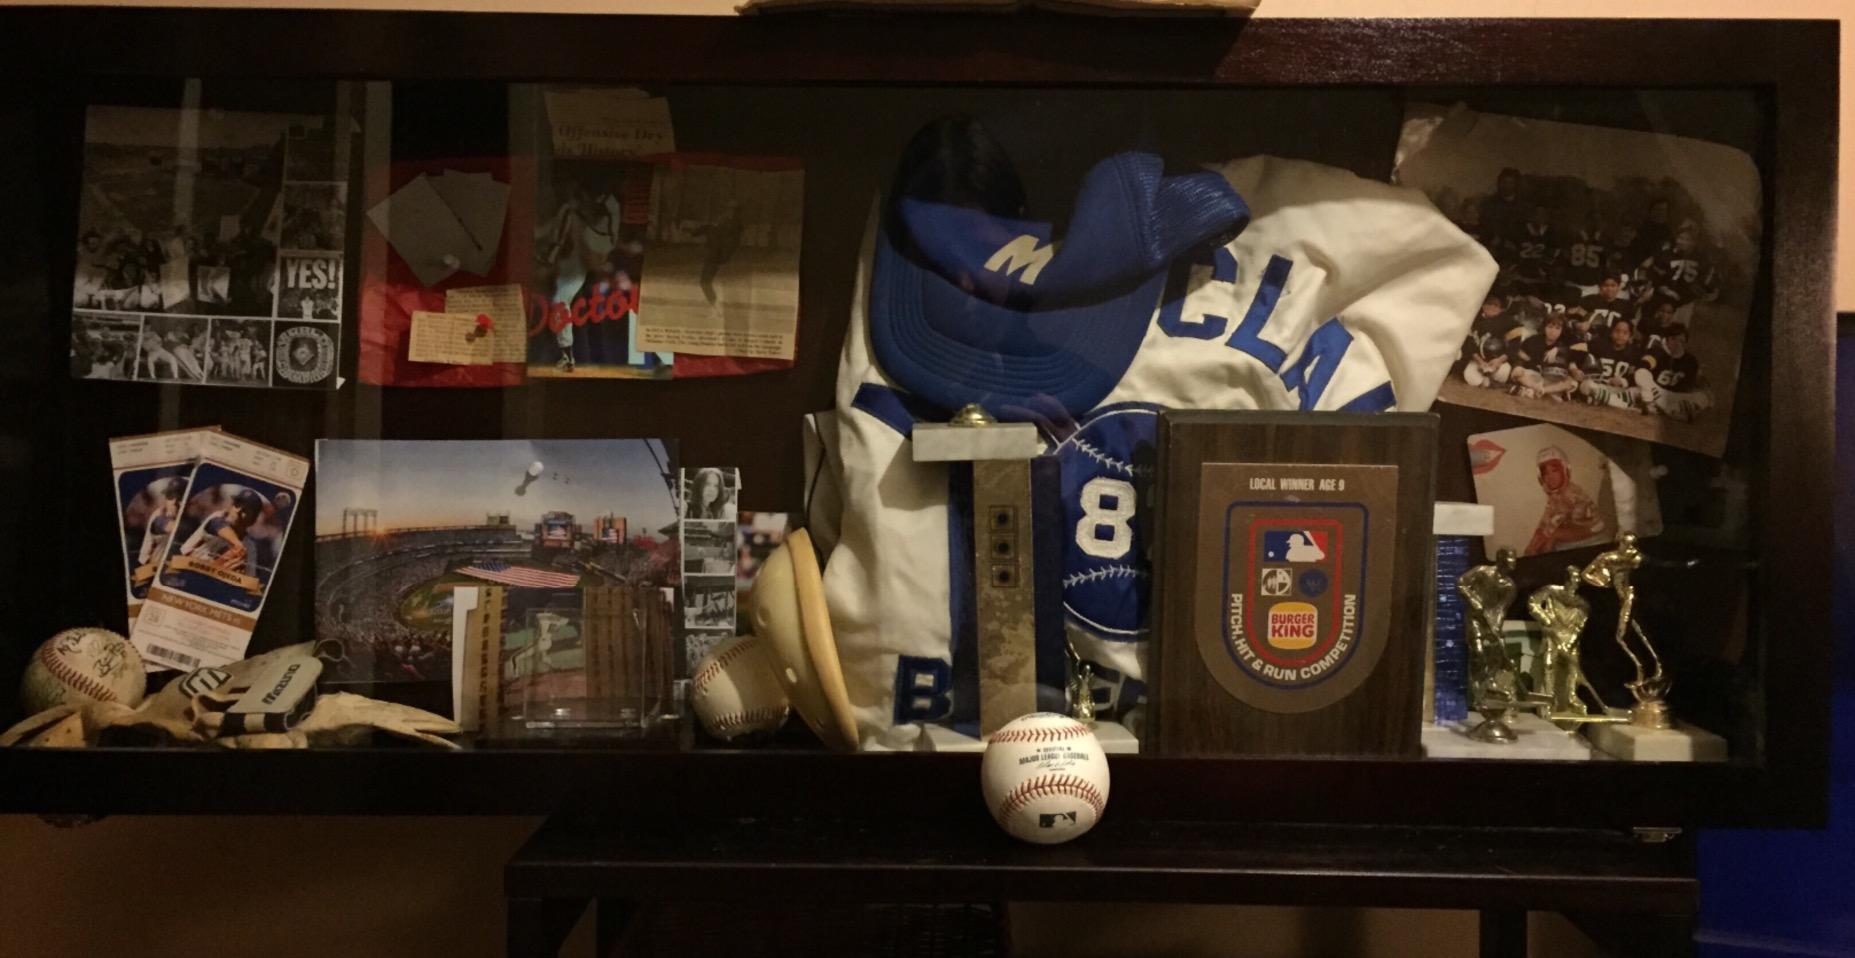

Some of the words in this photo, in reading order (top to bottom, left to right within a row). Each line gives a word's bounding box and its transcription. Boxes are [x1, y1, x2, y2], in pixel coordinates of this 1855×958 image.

[983, 233, 1055, 285] M
[1519, 241, 1546, 259] 22
[1570, 242, 1602, 268] 85
[286, 258, 336, 289] YES!
[1669, 258, 1699, 283] 75
[1249, 477, 1276, 490] LOCAL
[1280, 477, 1315, 491] WINNER
[1318, 479, 1337, 491] AGE
[1338, 479, 1345, 491] 9
[1075, 476, 1137, 560] 8
[1271, 613, 1315, 625] BURGER
[1271, 625, 1315, 638] KING
[1234, 638, 1256, 661] HIT
[1251, 659, 1264, 671] &
[1263, 664, 1297, 680] RUN
[1300, 594, 1357, 679] COMPETITION
